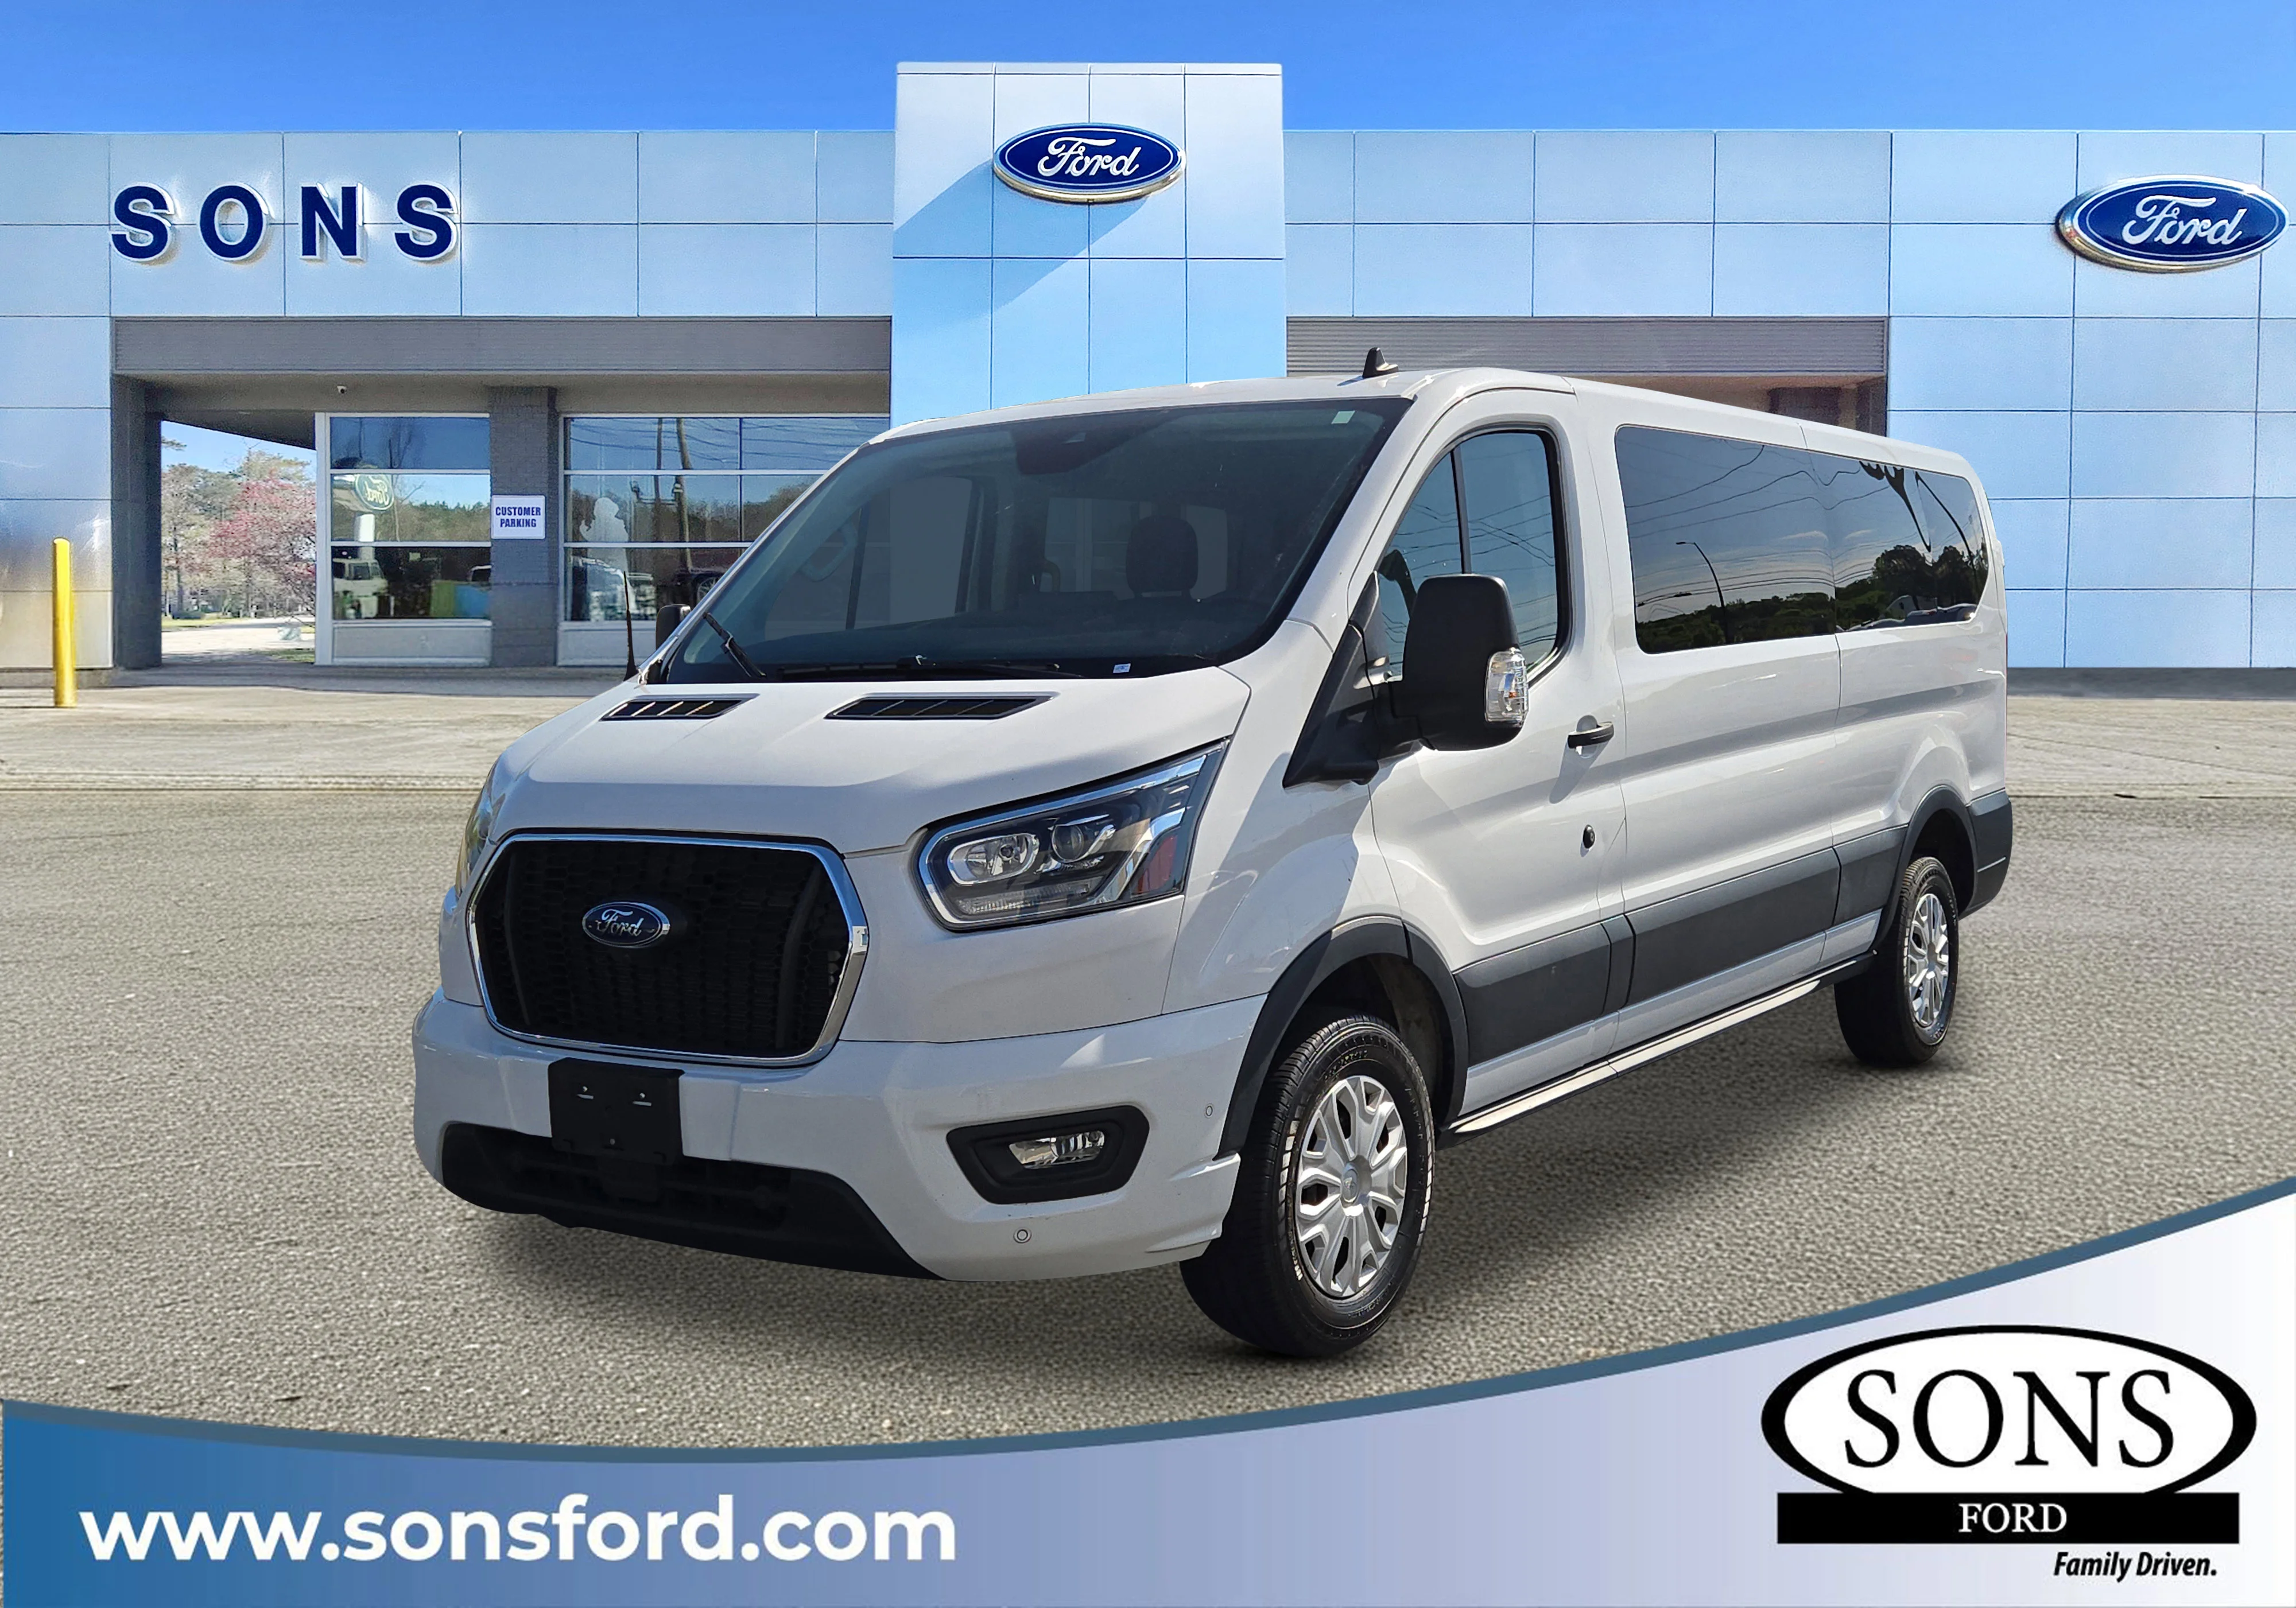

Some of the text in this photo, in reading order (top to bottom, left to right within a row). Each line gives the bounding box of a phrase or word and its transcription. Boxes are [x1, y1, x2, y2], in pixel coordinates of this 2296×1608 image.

[1037, 137, 1142, 177] Ford
[111, 184, 457, 259] SONS
[2123, 195, 2248, 246] Ford
[495, 506, 541, 516] CUSTOMER
[500, 518, 537, 527] PARKING
[595, 908, 645, 937] Ford
